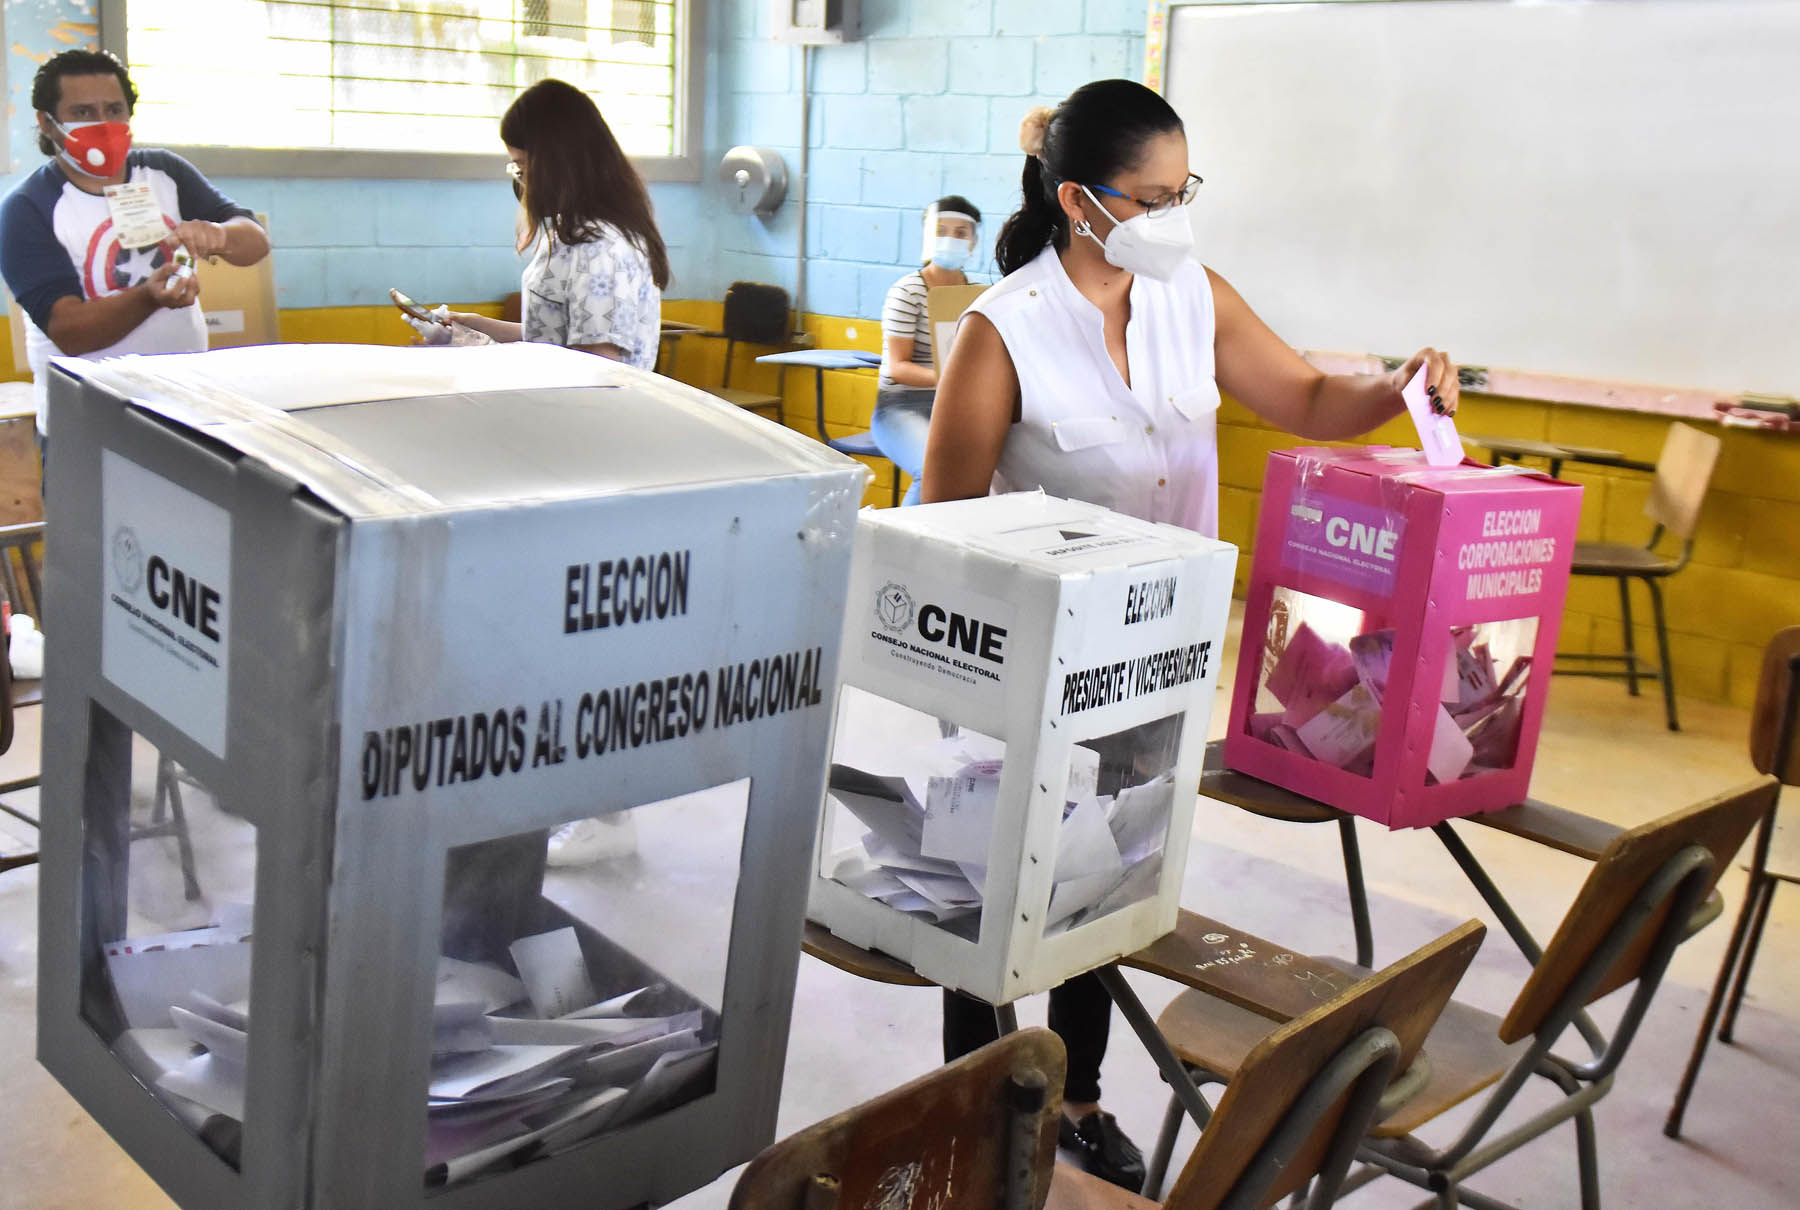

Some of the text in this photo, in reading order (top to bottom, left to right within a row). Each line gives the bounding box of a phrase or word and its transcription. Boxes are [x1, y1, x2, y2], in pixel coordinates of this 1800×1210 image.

[1326, 516, 1399, 562] CNE
[1482, 509, 1541, 537] ELECCION
[1458, 537, 1556, 570] CORPORACIONES
[147, 555, 220, 643] CNE
[563, 550, 691, 635] ELECCION
[1124, 576, 1178, 626] ELECCION
[1466, 567, 1543, 600] MUNICIPALES
[871, 630, 1001, 682] CONSEJO NACIONAL ELECTORAL
[917, 603, 1008, 665] CNE
[890, 648, 977, 685] Construyendo Democracia
[1060, 640, 1212, 716] PRESIDENTE Y VICEPRESIDENTE
[360, 646, 824, 801] DIPUTADOS AL CONGRESO NACIONAL
